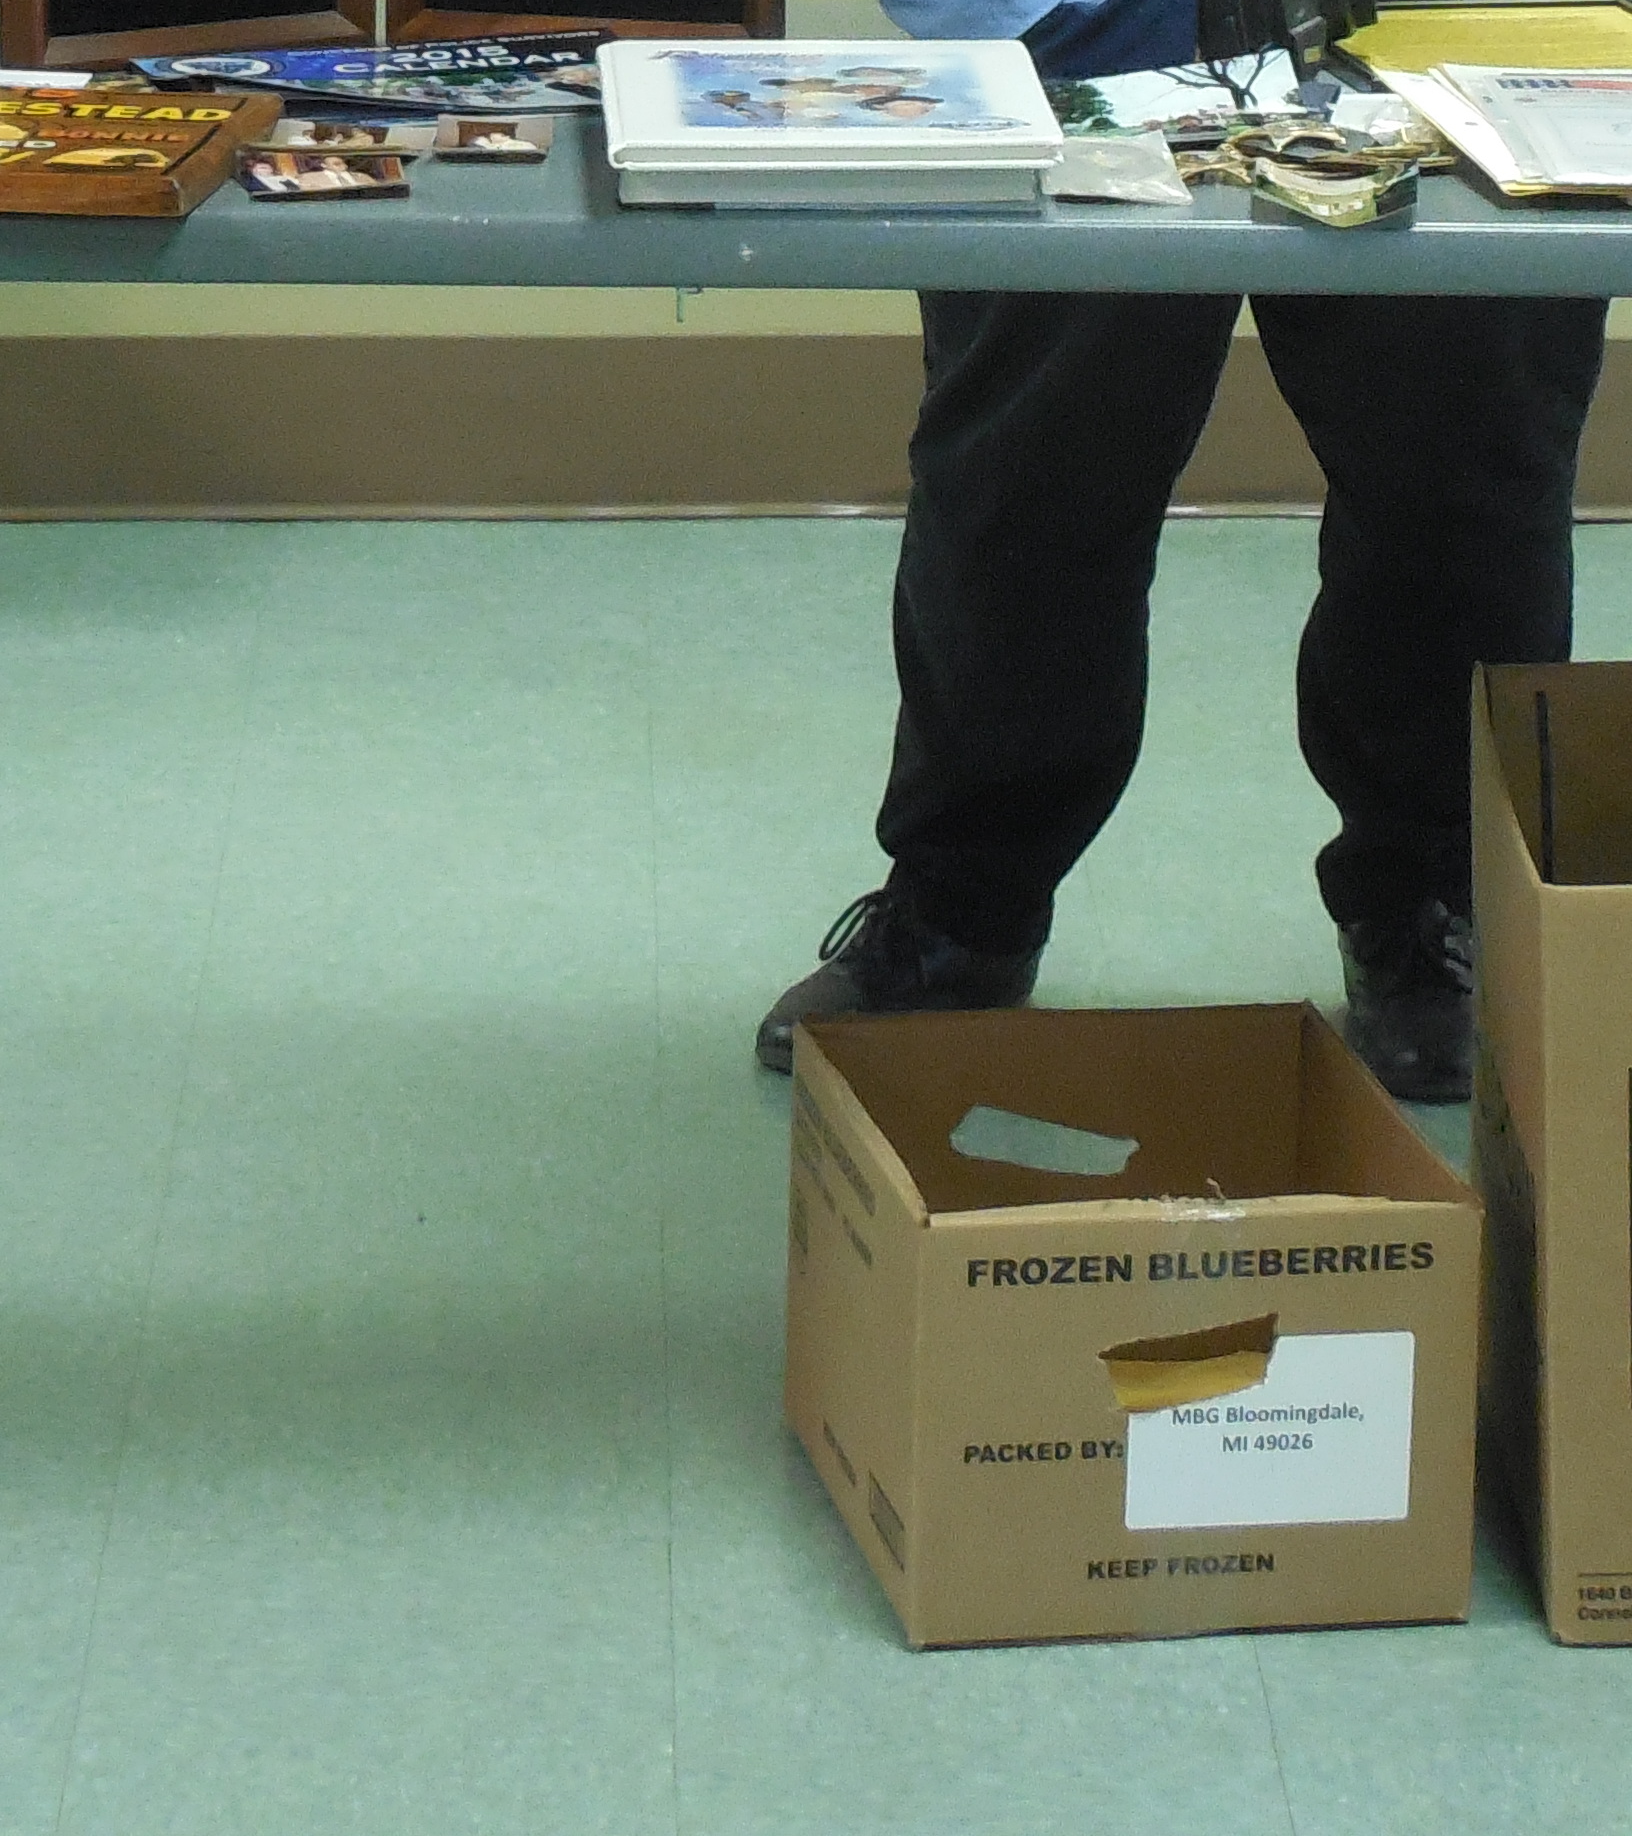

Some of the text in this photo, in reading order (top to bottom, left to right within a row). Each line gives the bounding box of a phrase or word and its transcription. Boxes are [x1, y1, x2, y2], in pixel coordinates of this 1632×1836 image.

[334, 51, 583, 73] CALENDAR
[391, 45, 510, 63] 2015
[967, 1241, 1436, 1288] FROZEN BLUEBERRIES
[1172, 1401, 1365, 1426] MBG Bloomingdale,
[963, 1439, 1125, 1464] PACKED BY:
[1222, 1431, 1314, 1454] MI 49026
[1086, 1552, 1274, 1580] KEEP FROZEN
